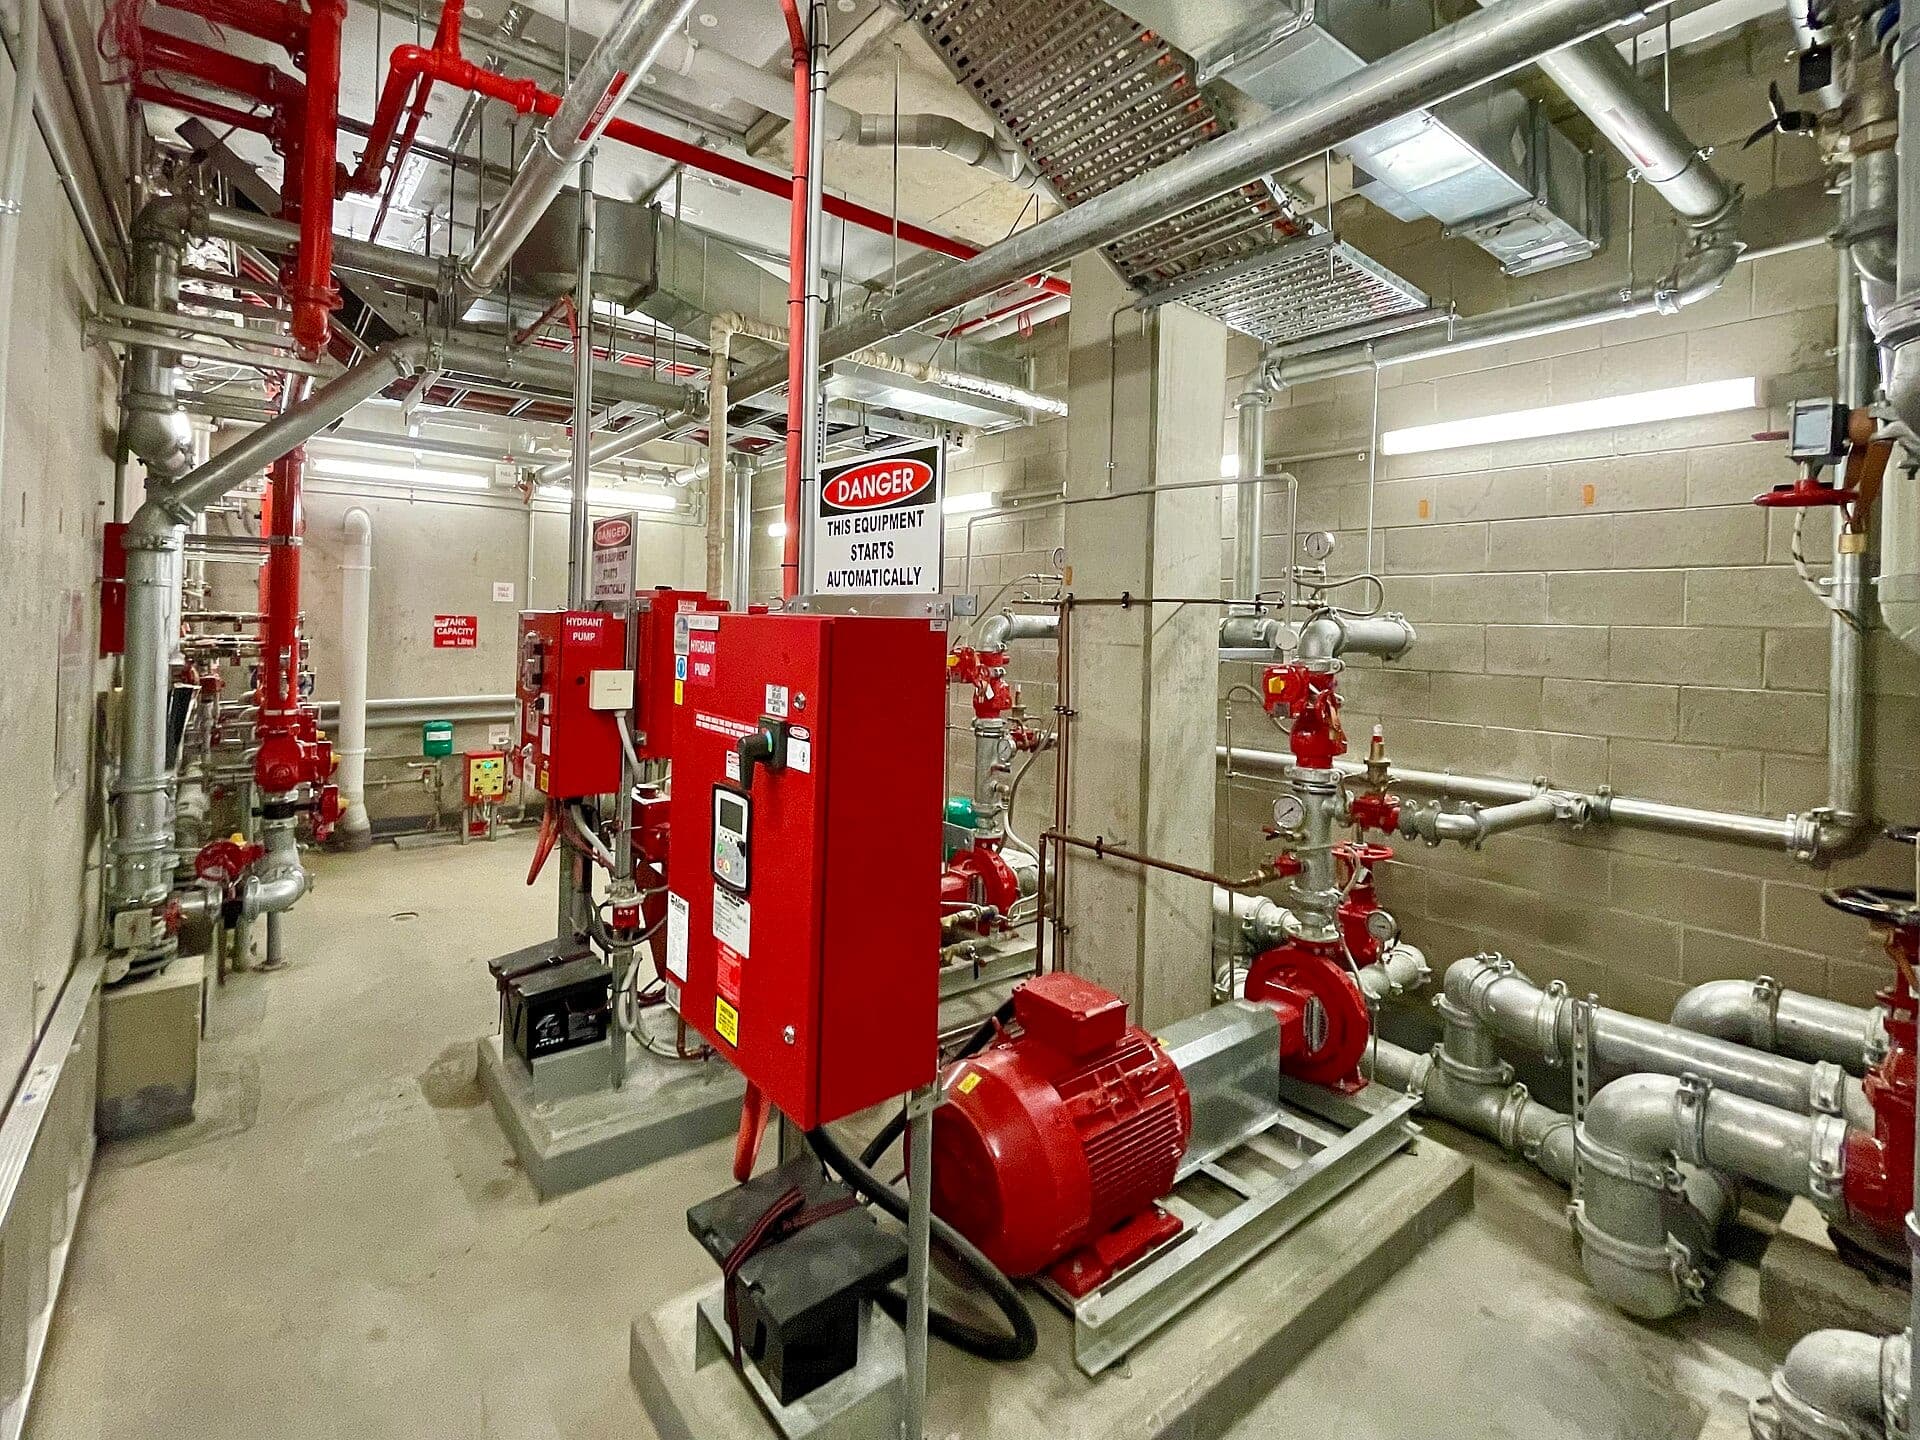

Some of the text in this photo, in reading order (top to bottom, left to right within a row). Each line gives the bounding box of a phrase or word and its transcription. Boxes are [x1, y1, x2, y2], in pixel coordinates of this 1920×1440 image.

[838, 467, 914, 503] DANGER
[827, 510, 924, 536] THIS EQUIPMENT
[597, 526, 627, 541] DANGER
[850, 541, 894, 561] STARTS
[827, 566, 922, 587] AUTOMATICALLY
[445, 618, 467, 627] TANK
[566, 616, 604, 627] HYDRANT
[436, 627, 474, 636] CAPACITY
[572, 631, 596, 641] PUMP
[690, 639, 716, 655] HYDRANT
[694, 662, 711, 677] PUMP
